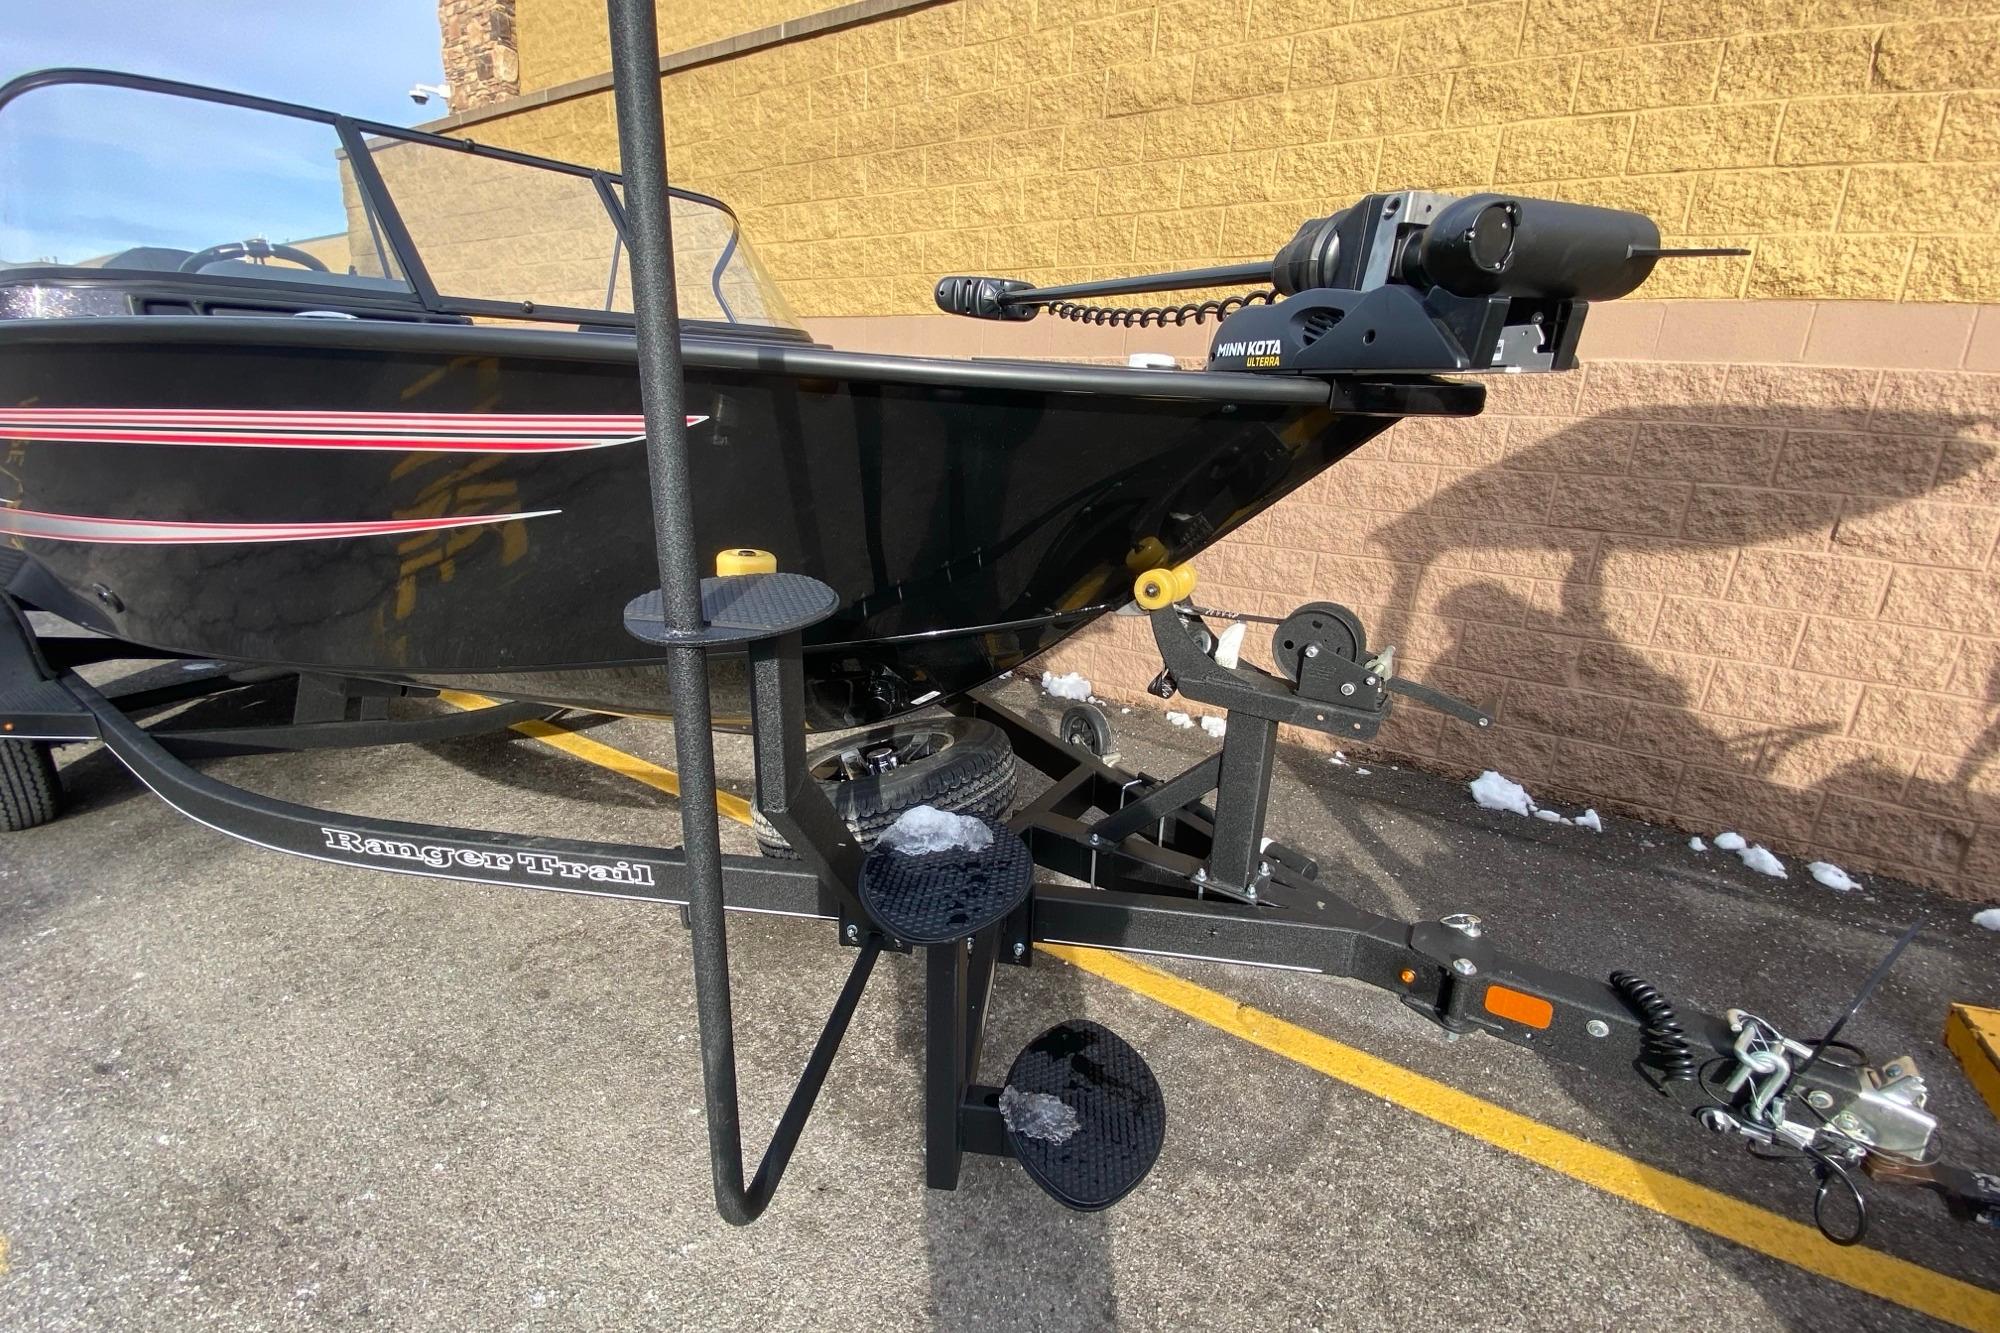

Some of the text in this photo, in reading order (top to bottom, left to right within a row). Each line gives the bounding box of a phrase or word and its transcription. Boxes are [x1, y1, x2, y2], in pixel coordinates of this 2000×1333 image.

[1217, 339, 1281, 357] MINN KOTA
[1246, 356, 1280, 367] ULTERRA
[322, 828, 655, 886] Ranger Trail
